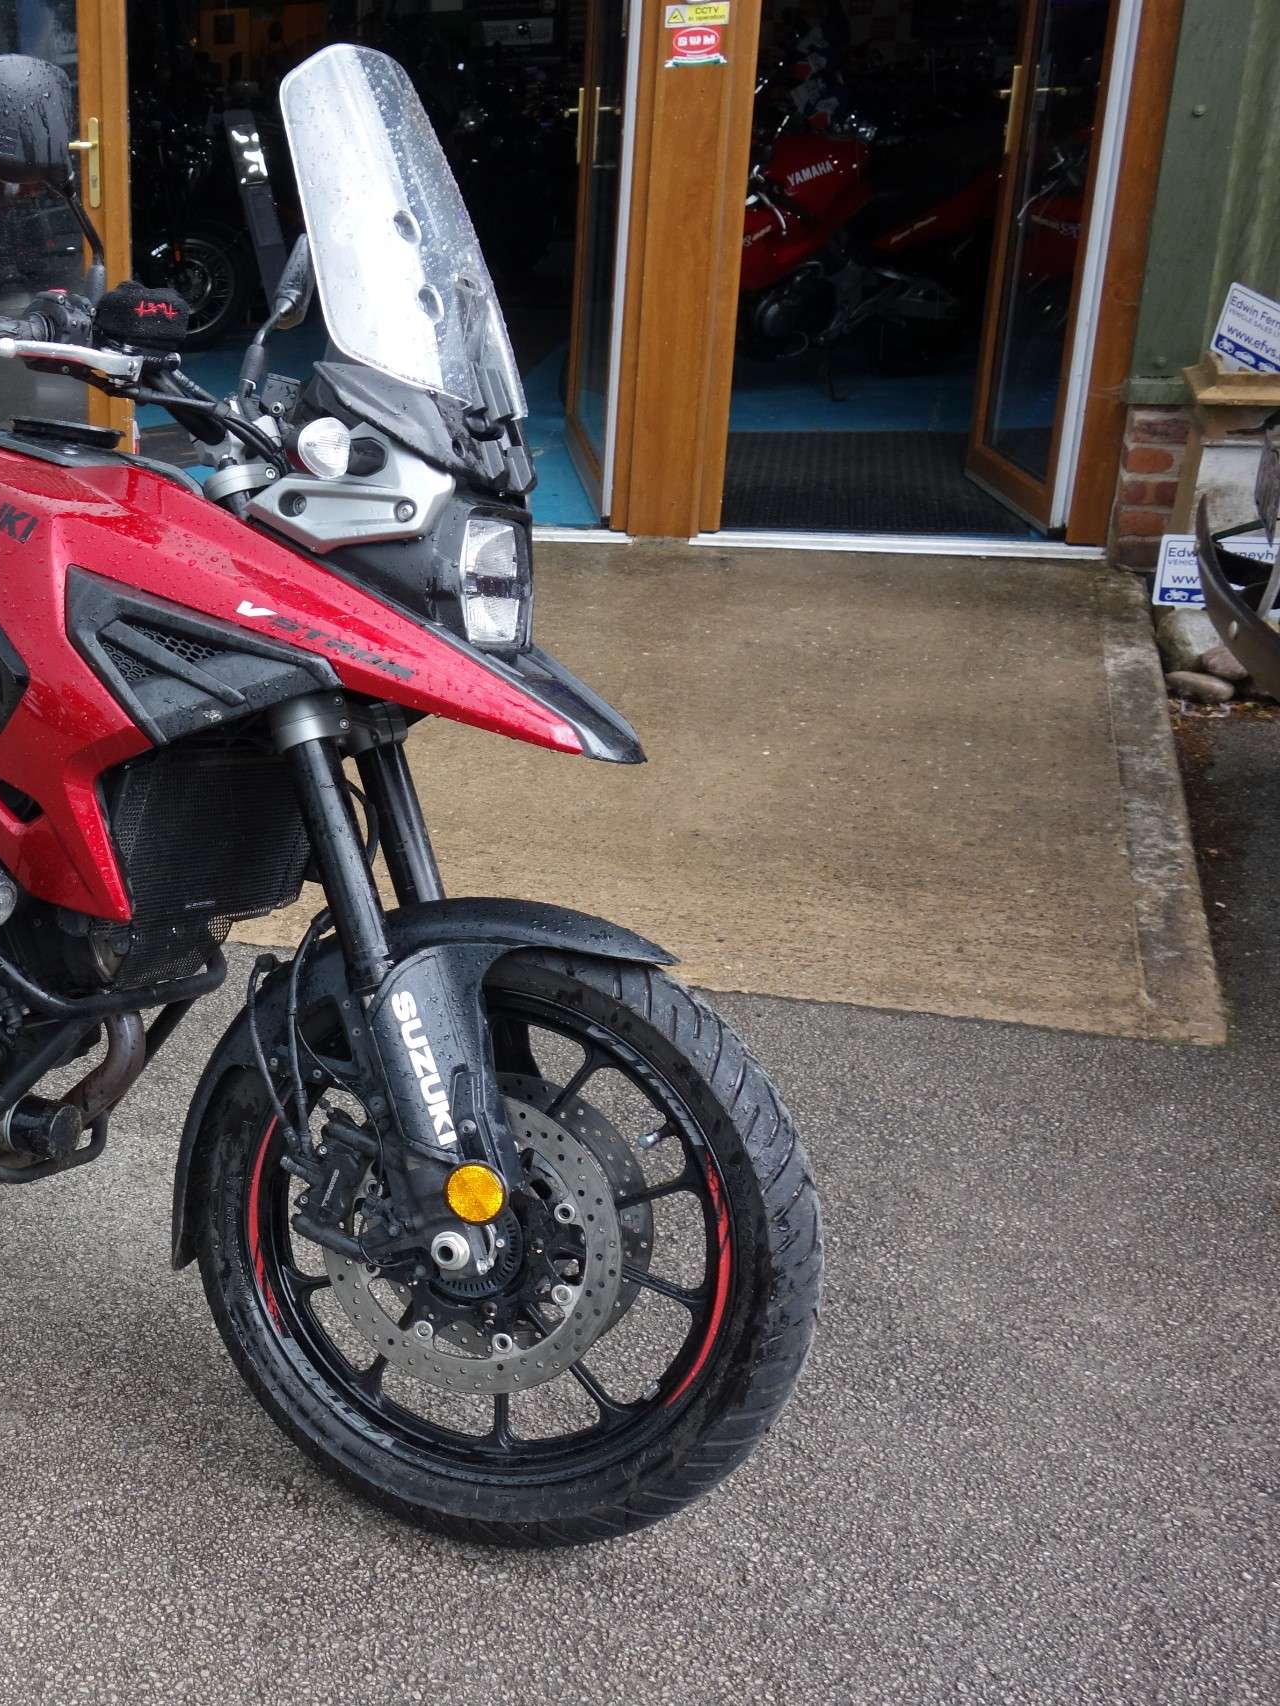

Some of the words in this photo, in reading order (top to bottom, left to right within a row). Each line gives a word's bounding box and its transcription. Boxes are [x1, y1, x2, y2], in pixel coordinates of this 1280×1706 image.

[695, 6, 719, 15] CCTV
[786, 159, 834, 187] YAMAHA
[1230, 295, 1259, 318] Edwin
[391, 990, 457, 1146] SUZUKI
